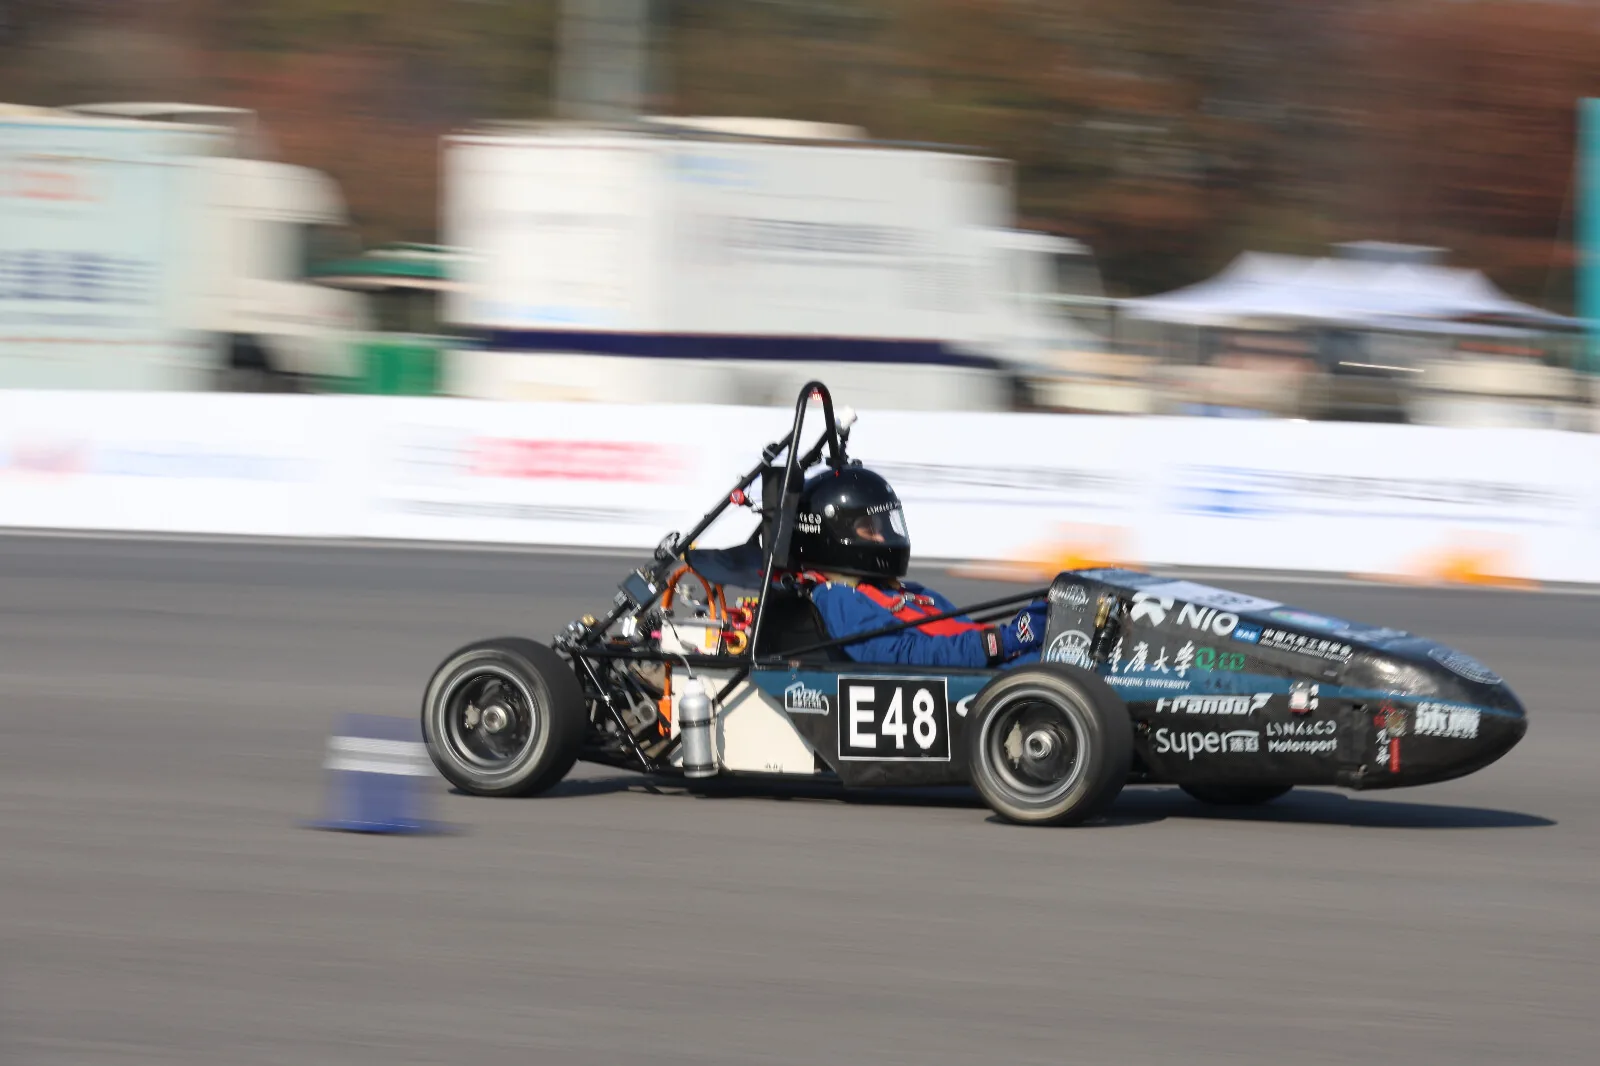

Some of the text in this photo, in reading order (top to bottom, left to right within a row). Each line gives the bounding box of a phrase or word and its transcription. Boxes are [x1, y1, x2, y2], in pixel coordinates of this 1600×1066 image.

[1177, 603, 1240, 637] NIO
[1104, 675, 1144, 688] HONGQING
[848, 685, 938, 750] E48
[1155, 728, 1259, 761] Super
